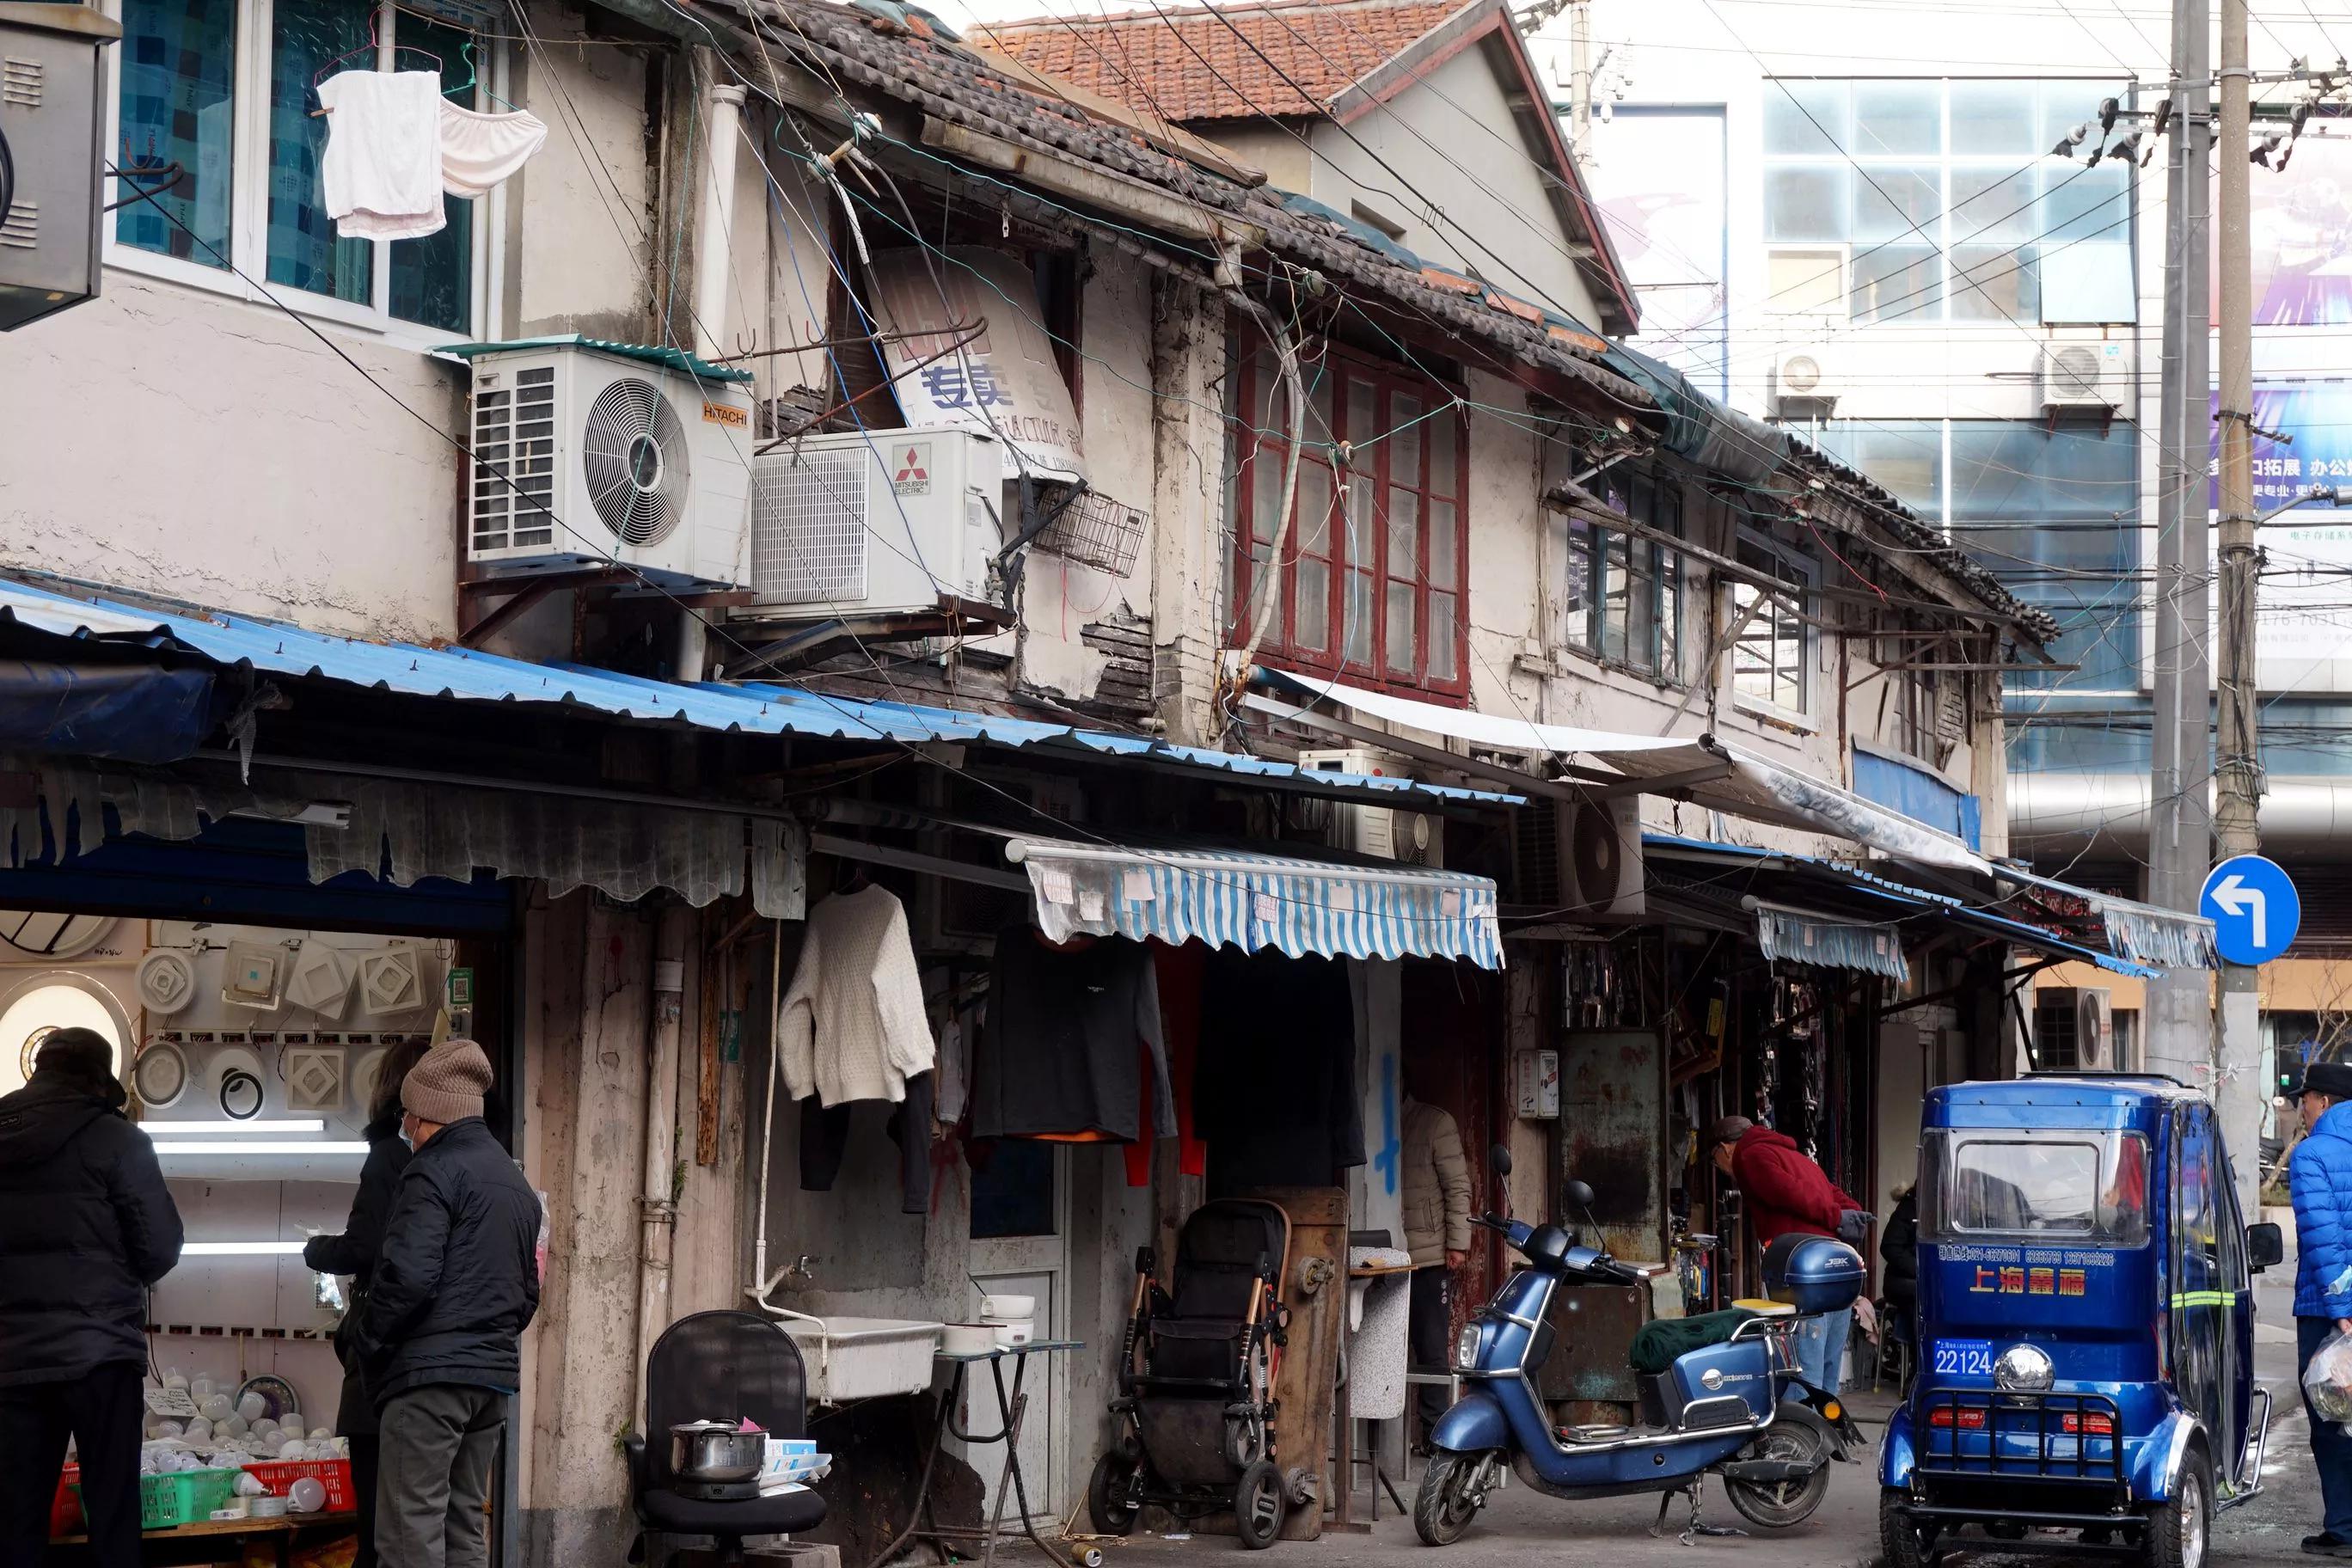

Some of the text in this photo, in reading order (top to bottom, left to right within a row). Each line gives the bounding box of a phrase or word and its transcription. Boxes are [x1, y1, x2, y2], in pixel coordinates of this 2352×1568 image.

[921, 361, 1014, 410] 专卖
[704, 405, 747, 426] HITACHI
[2310, 458, 2352, 476] 办公
[1969, 1265, 2086, 1295] 上海鑫福
[1936, 1350, 1990, 1375] 22124
